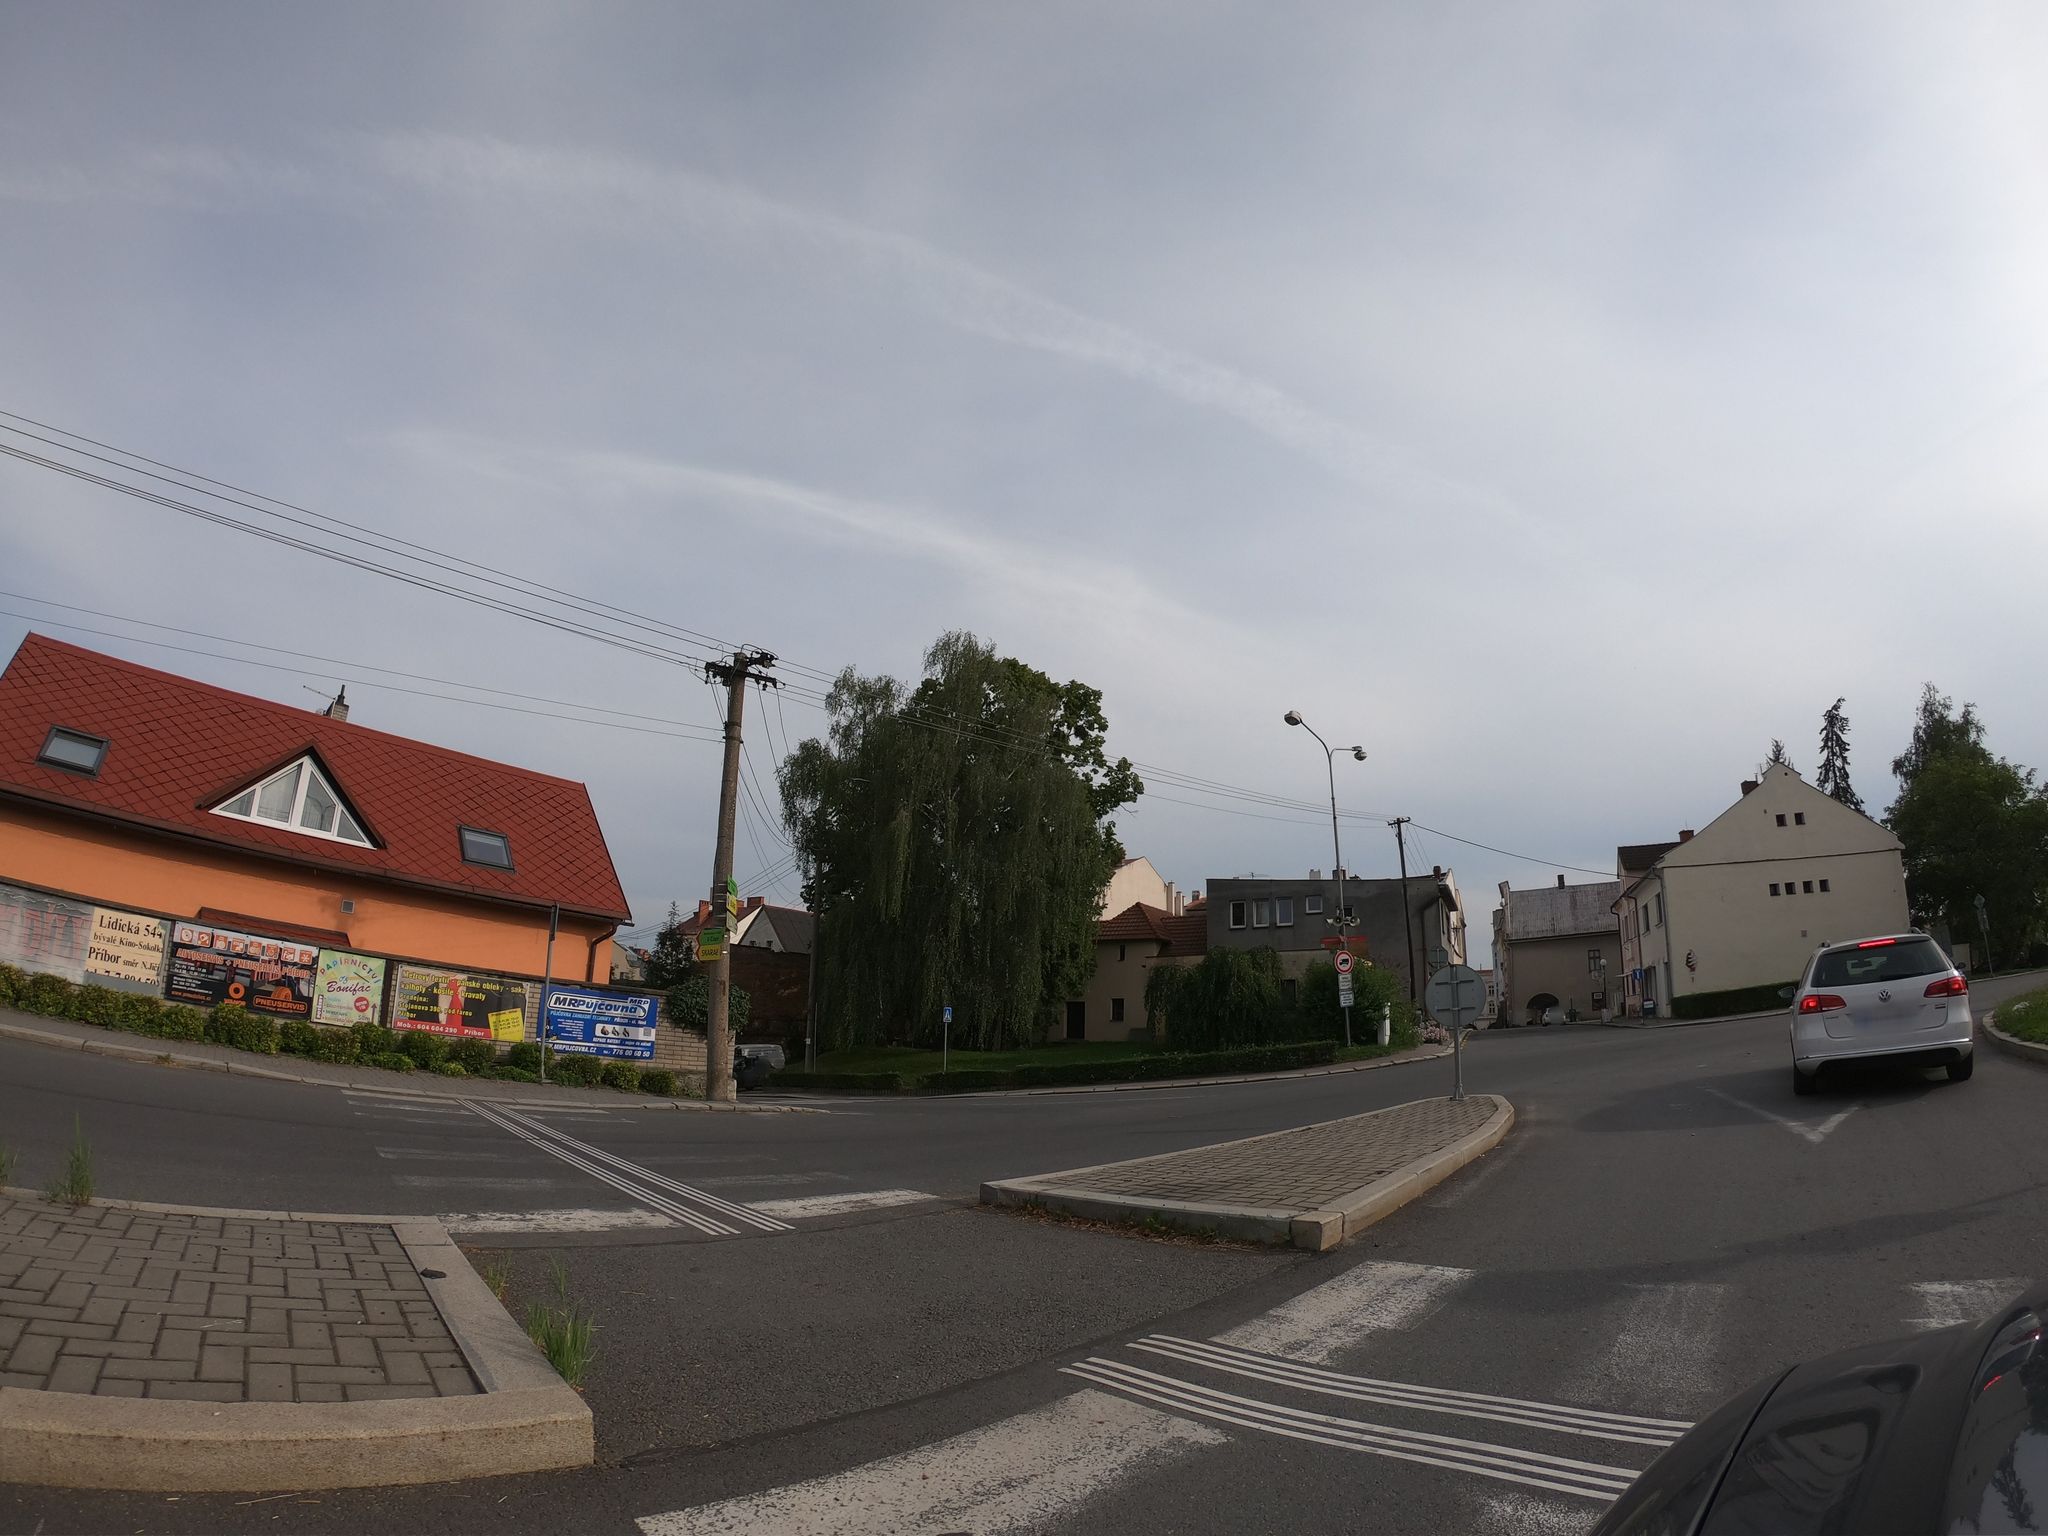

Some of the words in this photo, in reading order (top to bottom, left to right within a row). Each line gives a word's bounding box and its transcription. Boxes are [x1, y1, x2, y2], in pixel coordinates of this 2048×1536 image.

[99, 915, 140, 935] Lidická
[94, 932, 117, 944] bývalé
[88, 946, 121, 964] Příbor
[122, 959, 139, 968] směr
[176, 947, 225, 965] AUTOSERVIS
[232, 959, 280, 974] PNEUSERVIS
[482, 983, 504, 992] obleky
[462, 990, 486, 1002] kravaty
[628, 998, 649, 1006] MRP
[256, 997, 305, 1011] PNEUSERVIS
